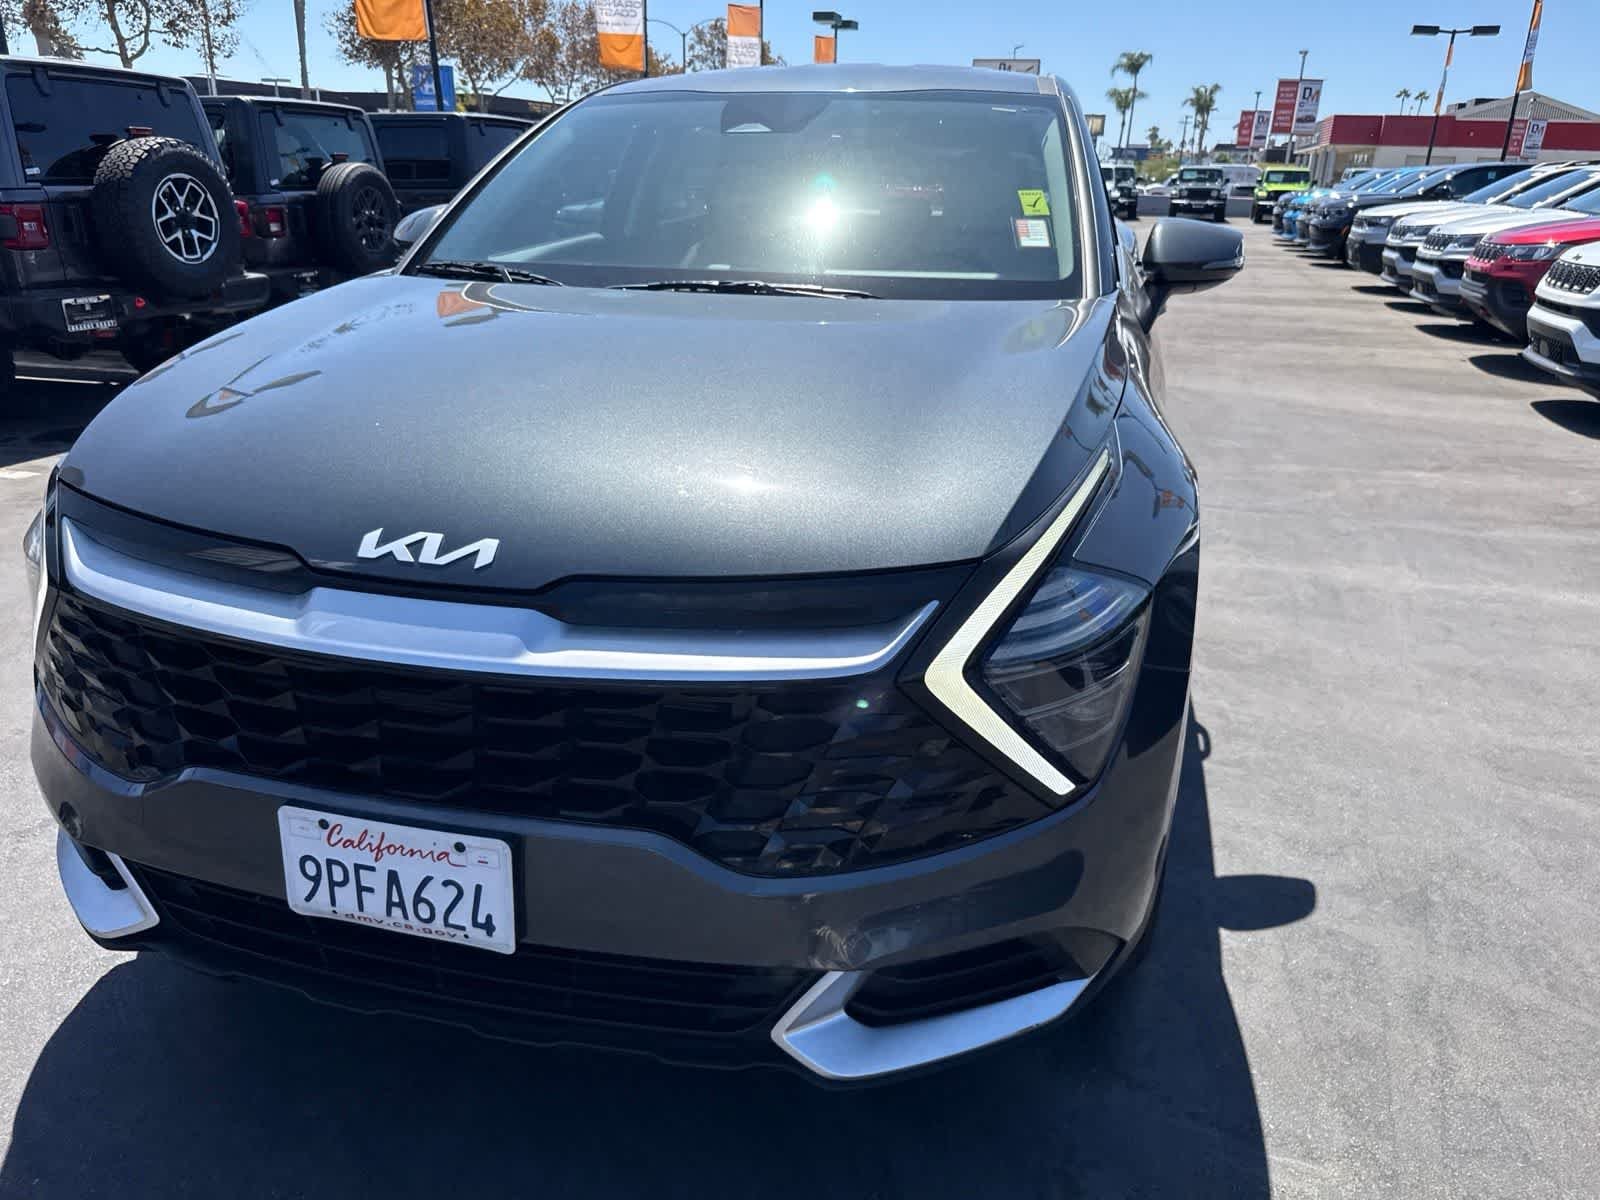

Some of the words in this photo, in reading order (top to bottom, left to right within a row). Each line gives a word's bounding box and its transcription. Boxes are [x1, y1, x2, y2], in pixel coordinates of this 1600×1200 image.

[326, 823, 466, 867] California
[299, 854, 497, 938] 9PFA624
[344, 912, 457, 938] dmv.ca.gov
